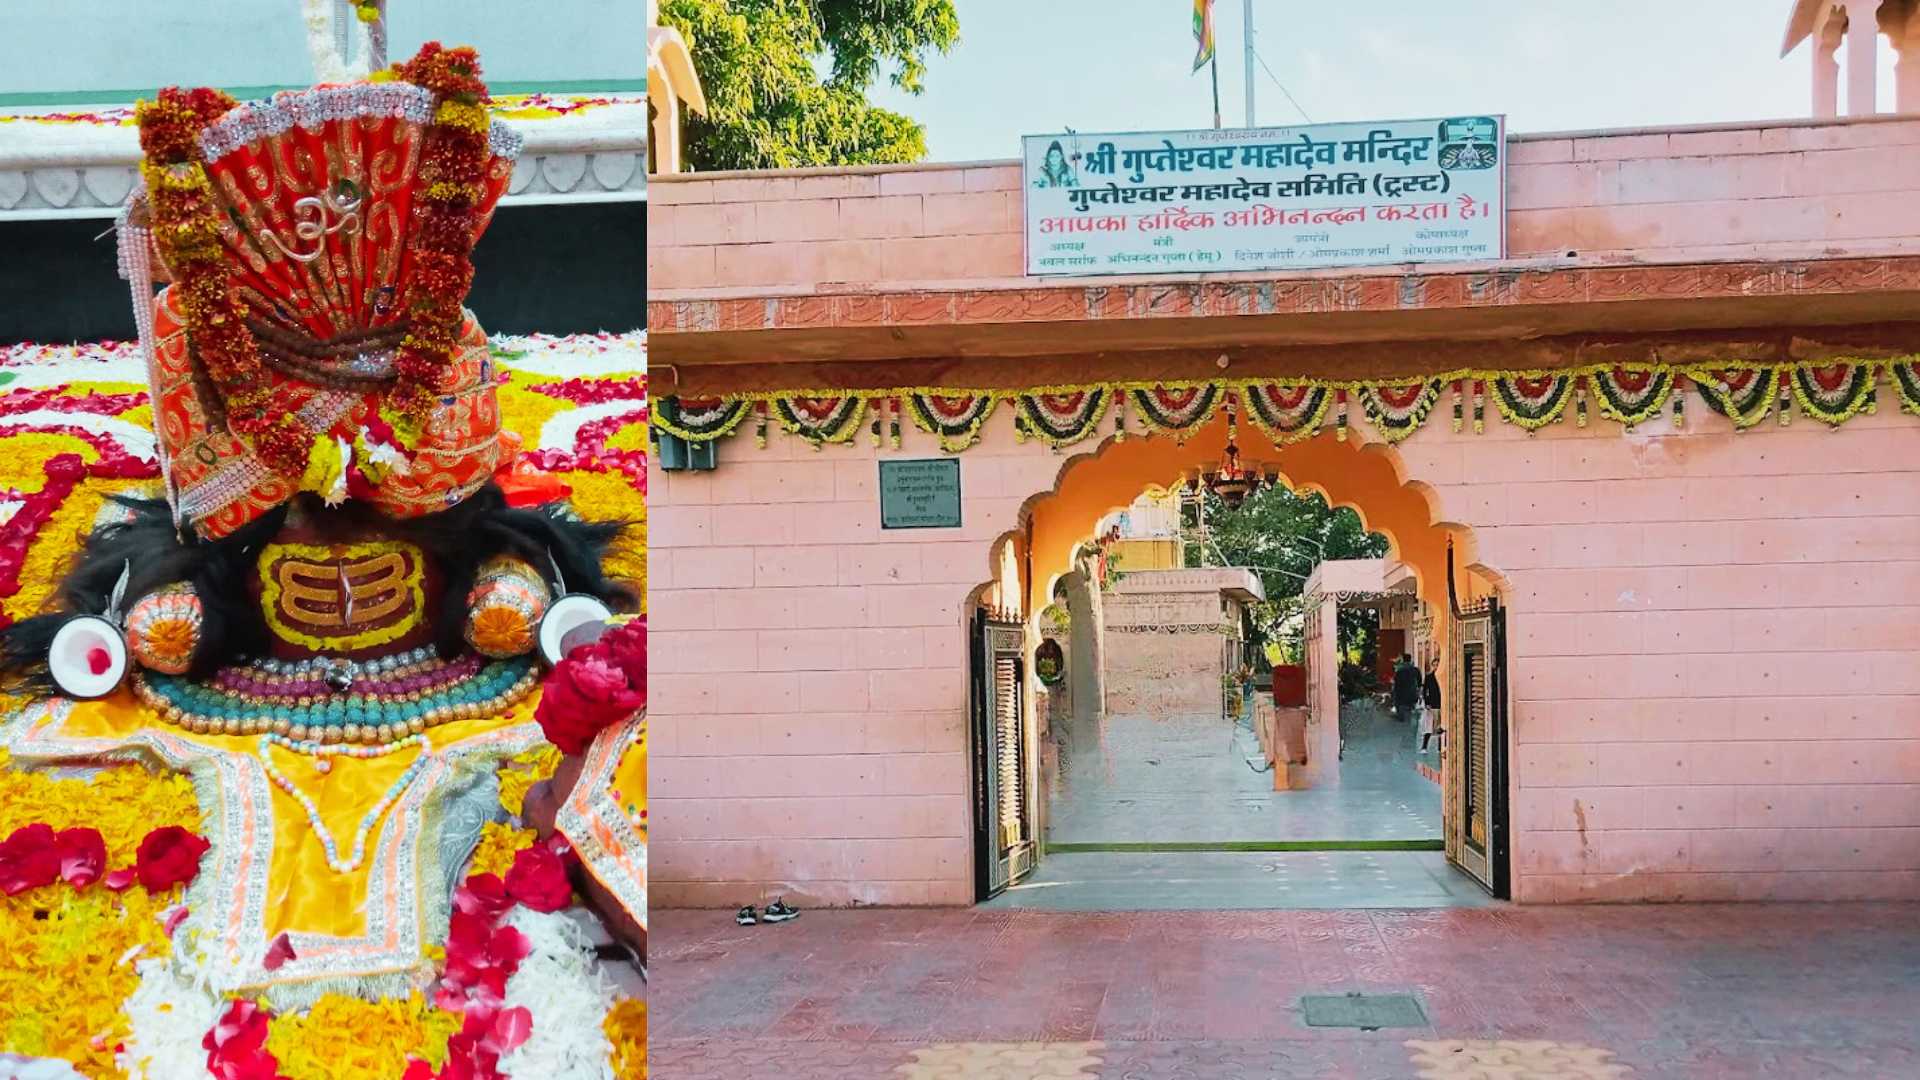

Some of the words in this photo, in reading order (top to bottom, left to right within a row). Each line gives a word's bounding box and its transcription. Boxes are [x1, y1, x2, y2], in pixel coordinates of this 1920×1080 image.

[1084, 141, 1117, 175] श्री
[1122, 139, 1237, 183] गुप्तेश्वर
[1240, 133, 1337, 170] महादेव
[1341, 129, 1434, 166] मन्दिर
[1068, 182, 1178, 212] गुप्तेश्वर
[1180, 176, 1272, 203] महादेव
[1276, 172, 1368, 198] समिति
[1373, 170, 1451, 198] (ट्रस्ट)
[1039, 214, 1128, 234] आपका
[1132, 206, 1216, 232] हार्दिक
[1223, 203, 1366, 228] अभिनन्दन
[1371, 202, 1450, 222] करता
